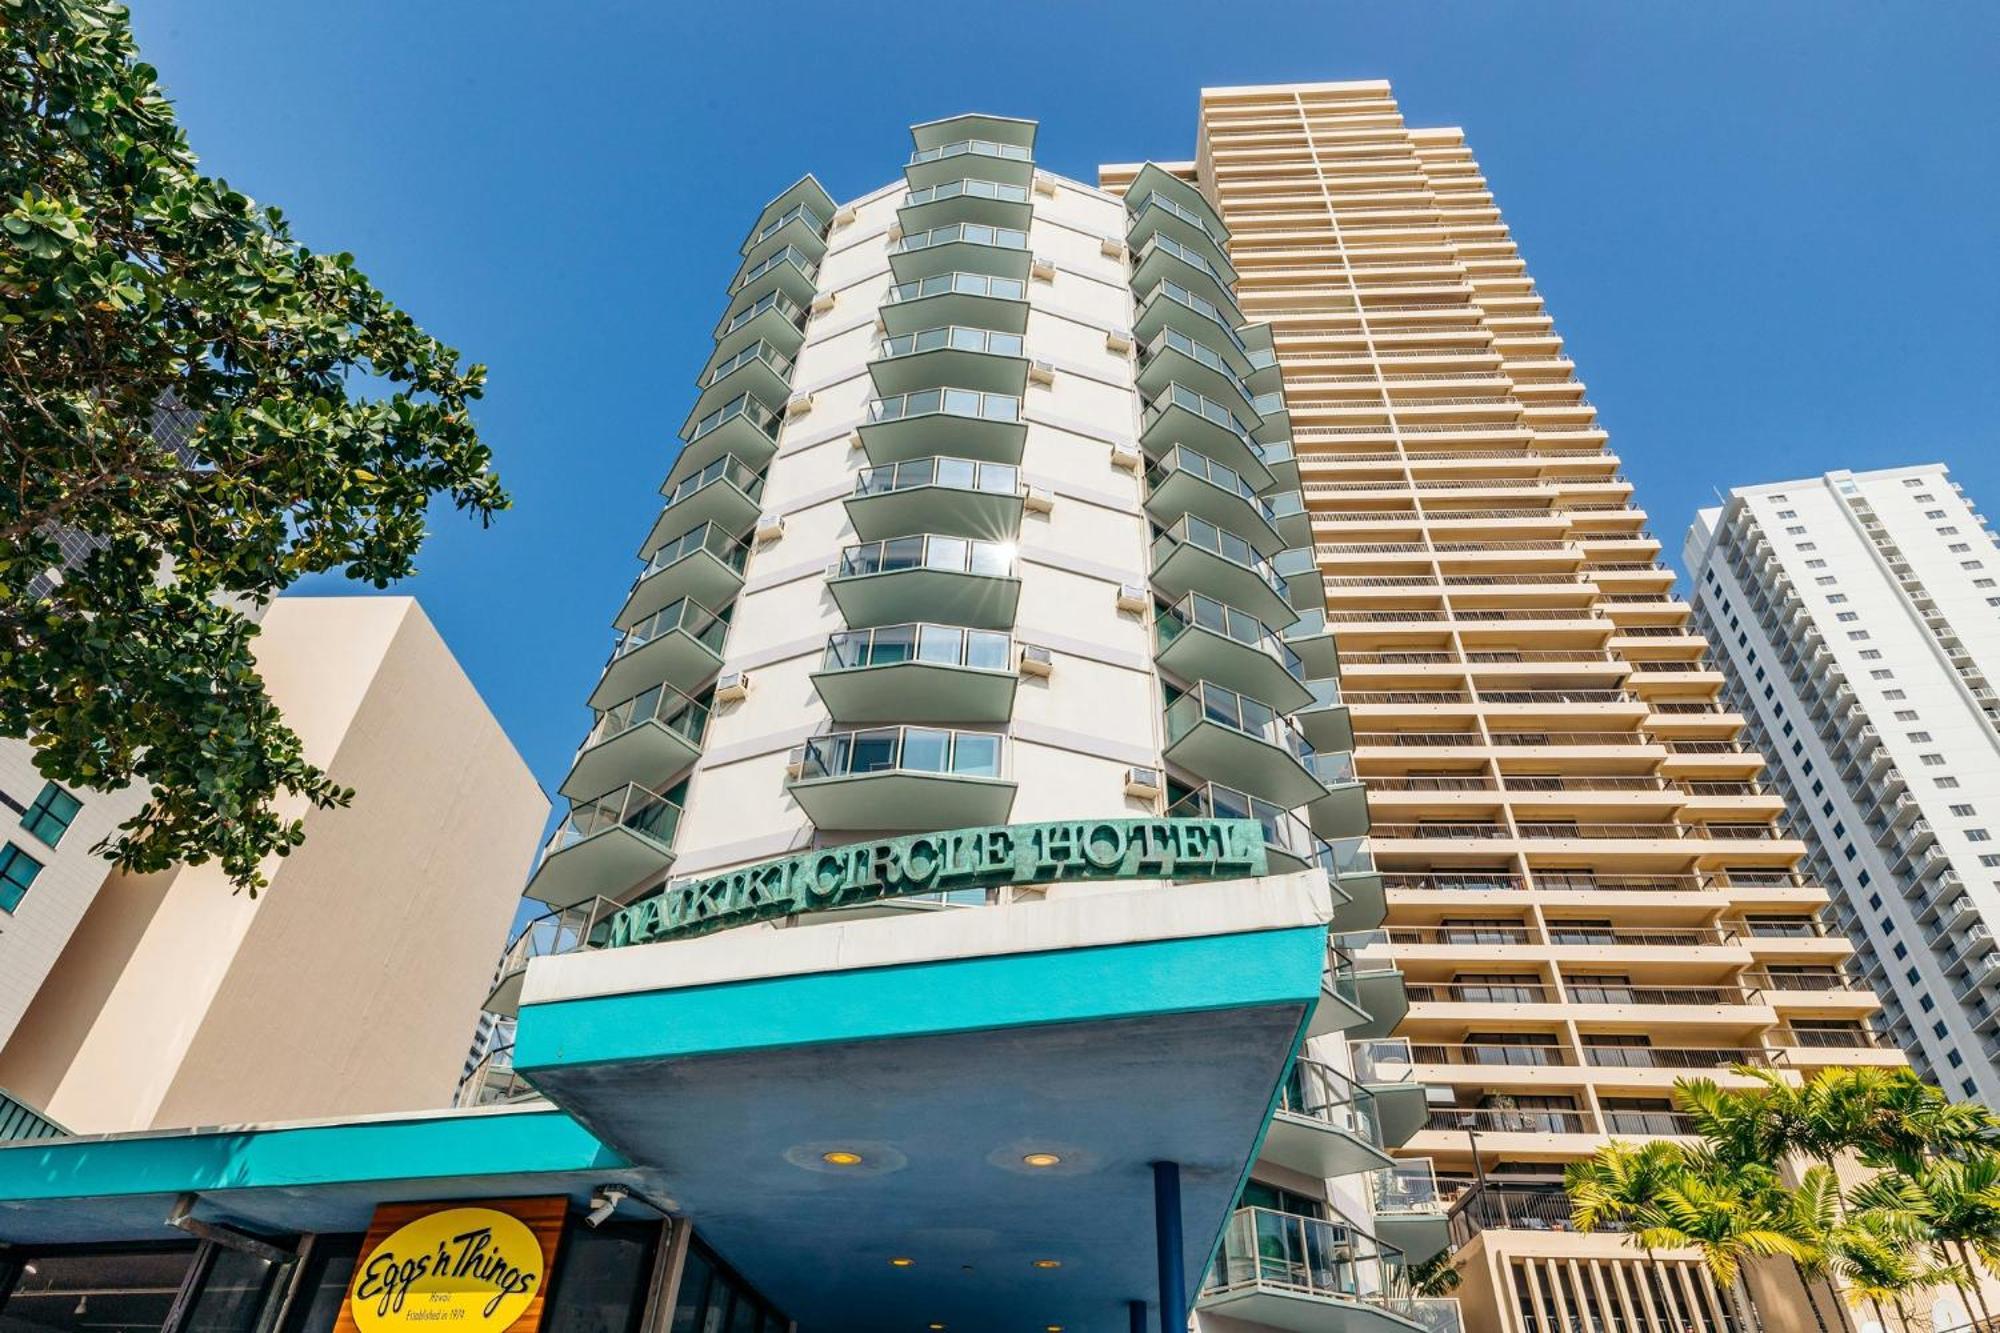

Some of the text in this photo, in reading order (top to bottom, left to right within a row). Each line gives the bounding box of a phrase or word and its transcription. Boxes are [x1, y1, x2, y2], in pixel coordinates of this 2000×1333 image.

[805, 831, 1014, 897] CIRCLE
[1032, 822, 1253, 869] HOTEL
[357, 1252, 431, 1317] Eggs
[451, 1227, 536, 1318] Things
[406, 1308, 441, 1321] Established
[441, 1308, 448, 1320] in
